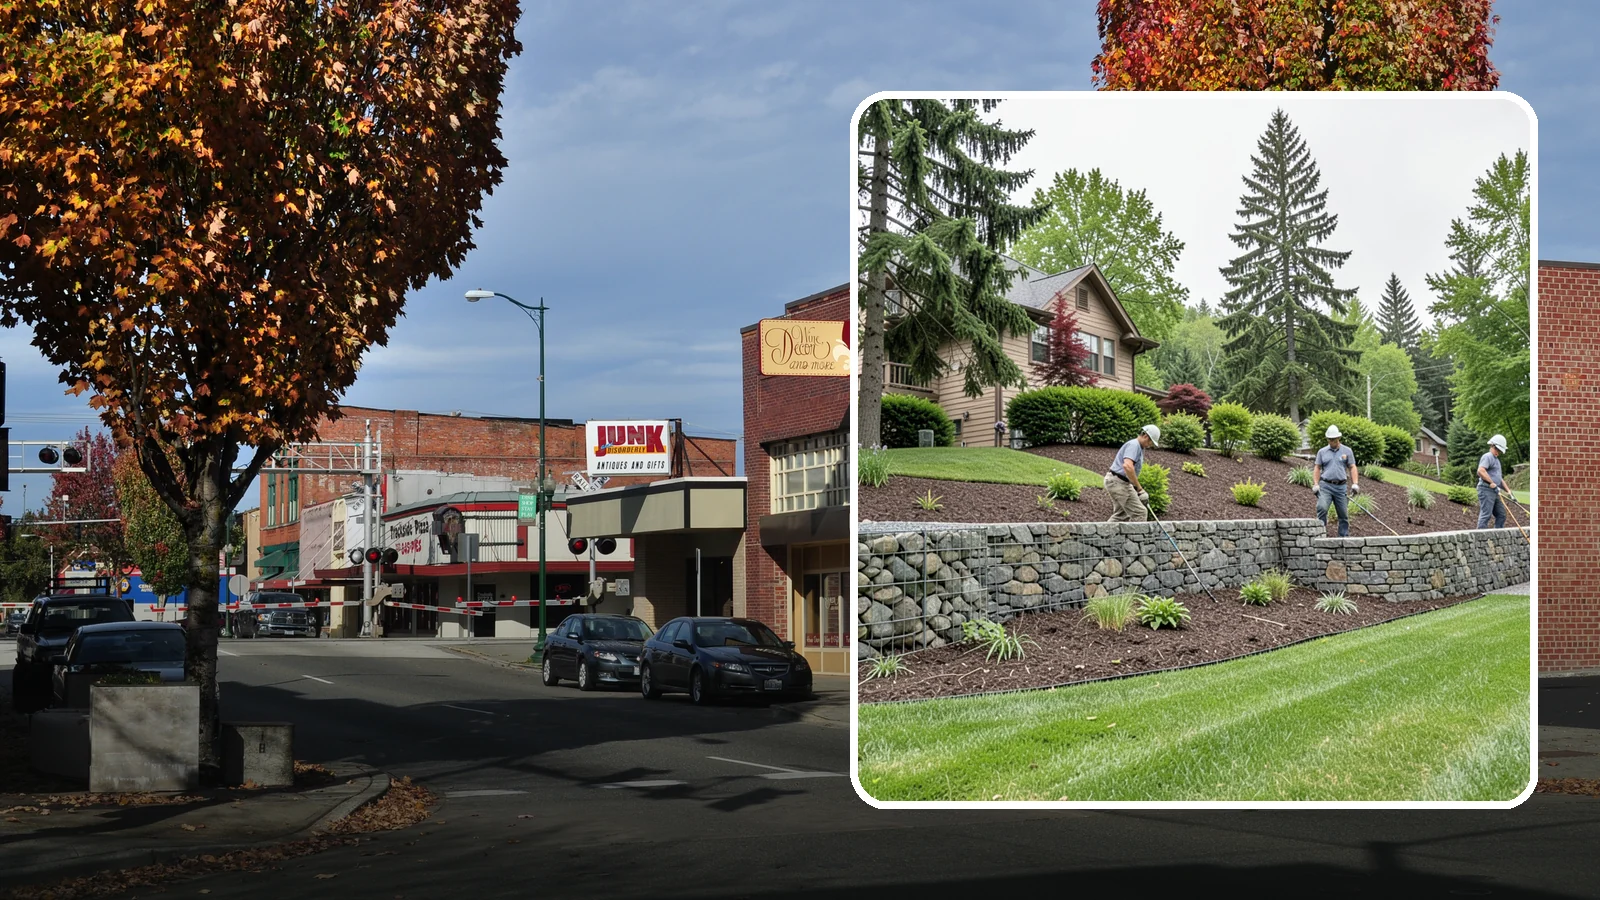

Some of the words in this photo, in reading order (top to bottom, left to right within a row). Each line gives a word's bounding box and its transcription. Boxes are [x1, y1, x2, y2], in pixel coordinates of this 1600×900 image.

[595, 425, 665, 457] JUNK
[607, 446, 646, 454] DISORDERLY
[596, 461, 628, 470] ANTIQUES
[631, 461, 644, 470] AND
[647, 460, 666, 469] GIFTS
[573, 473, 589, 492] RAIL
[414, 519, 429, 535] Pizza
